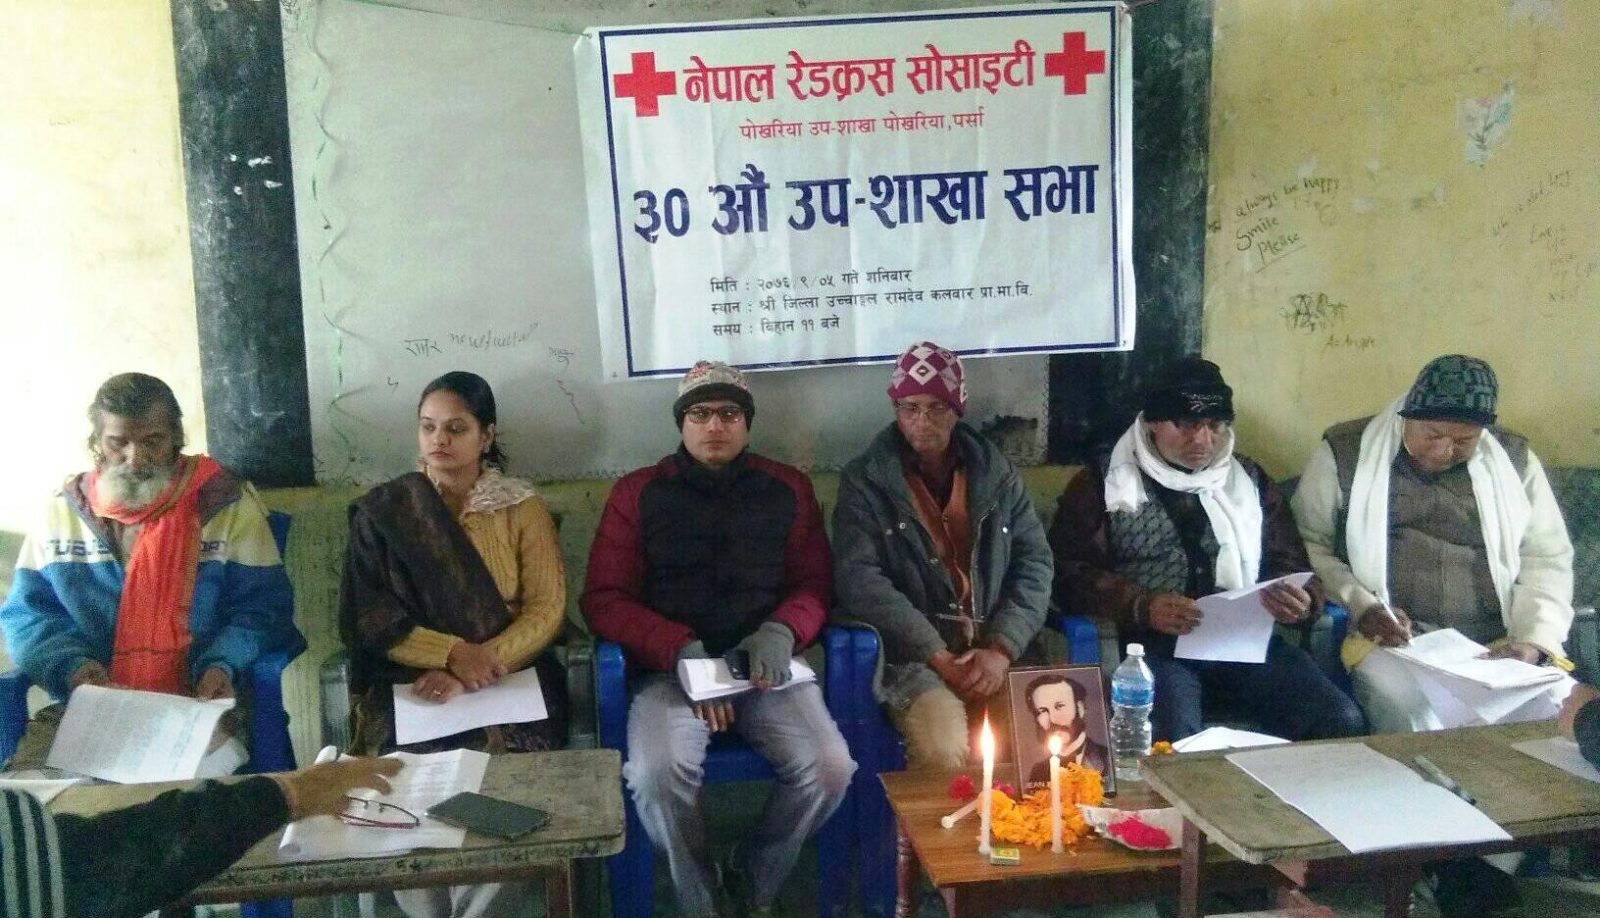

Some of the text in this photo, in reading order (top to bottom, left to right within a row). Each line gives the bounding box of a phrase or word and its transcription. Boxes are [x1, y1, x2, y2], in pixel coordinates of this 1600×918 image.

[683, 39, 1036, 104] नेपाल रेडक्रस सोसाइटी
[740, 118, 803, 139] पोखरिया
[809, 118, 876, 135] उप-शाखा
[633, 188, 690, 244] ३०
[785, 170, 988, 232] उप-शाखा
[1003, 163, 1100, 217] सभा
[1236, 216, 1280, 252] Smile
[710, 277, 738, 292] मिति
[841, 270, 859, 285] गते
[759, 295, 776, 311] श्री
[783, 294, 819, 310] जिल्ला
[884, 287, 924, 305] रामदेव
[712, 323, 742, 336] समय
[821, 315, 841, 329] बजे
